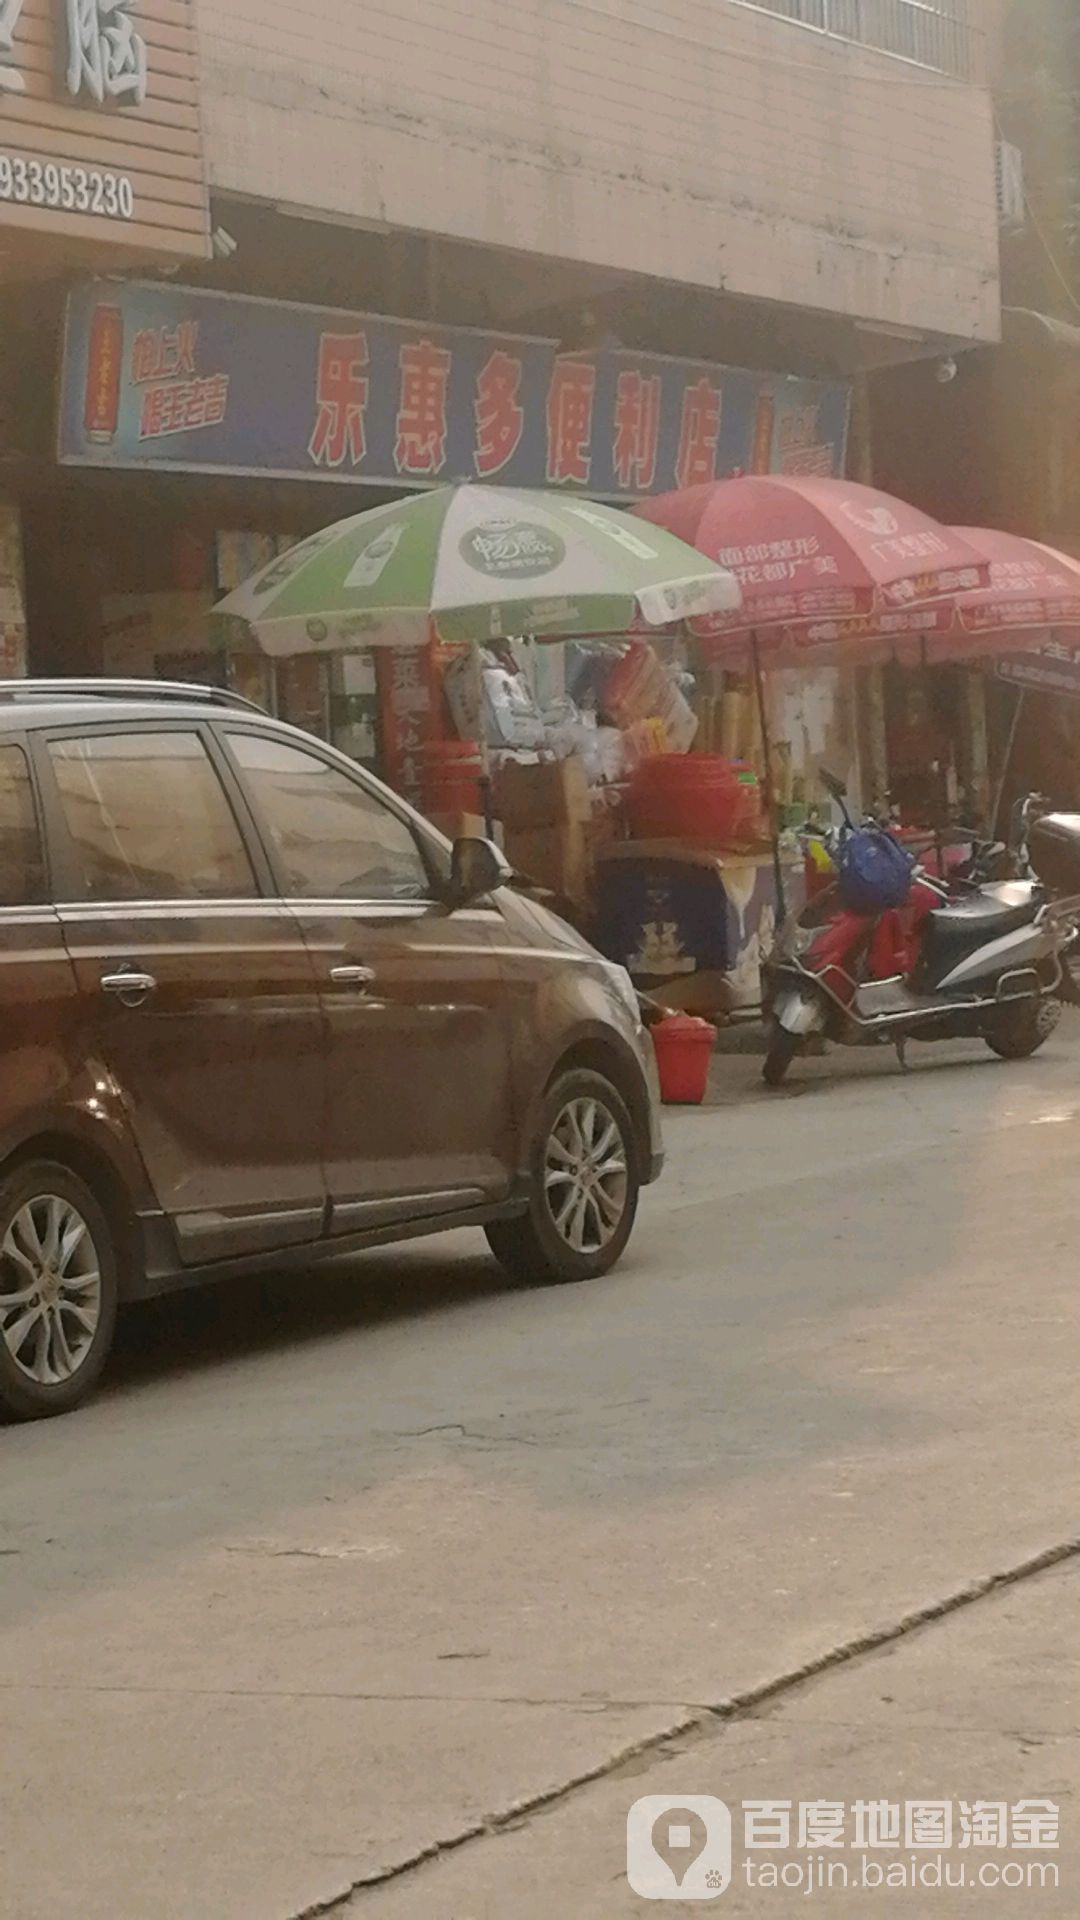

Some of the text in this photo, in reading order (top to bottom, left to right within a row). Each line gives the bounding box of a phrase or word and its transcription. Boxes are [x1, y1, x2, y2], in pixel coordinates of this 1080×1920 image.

[0, 155, 133, 218] 933953230
[307, 331, 722, 490] 乐惠多便利店
